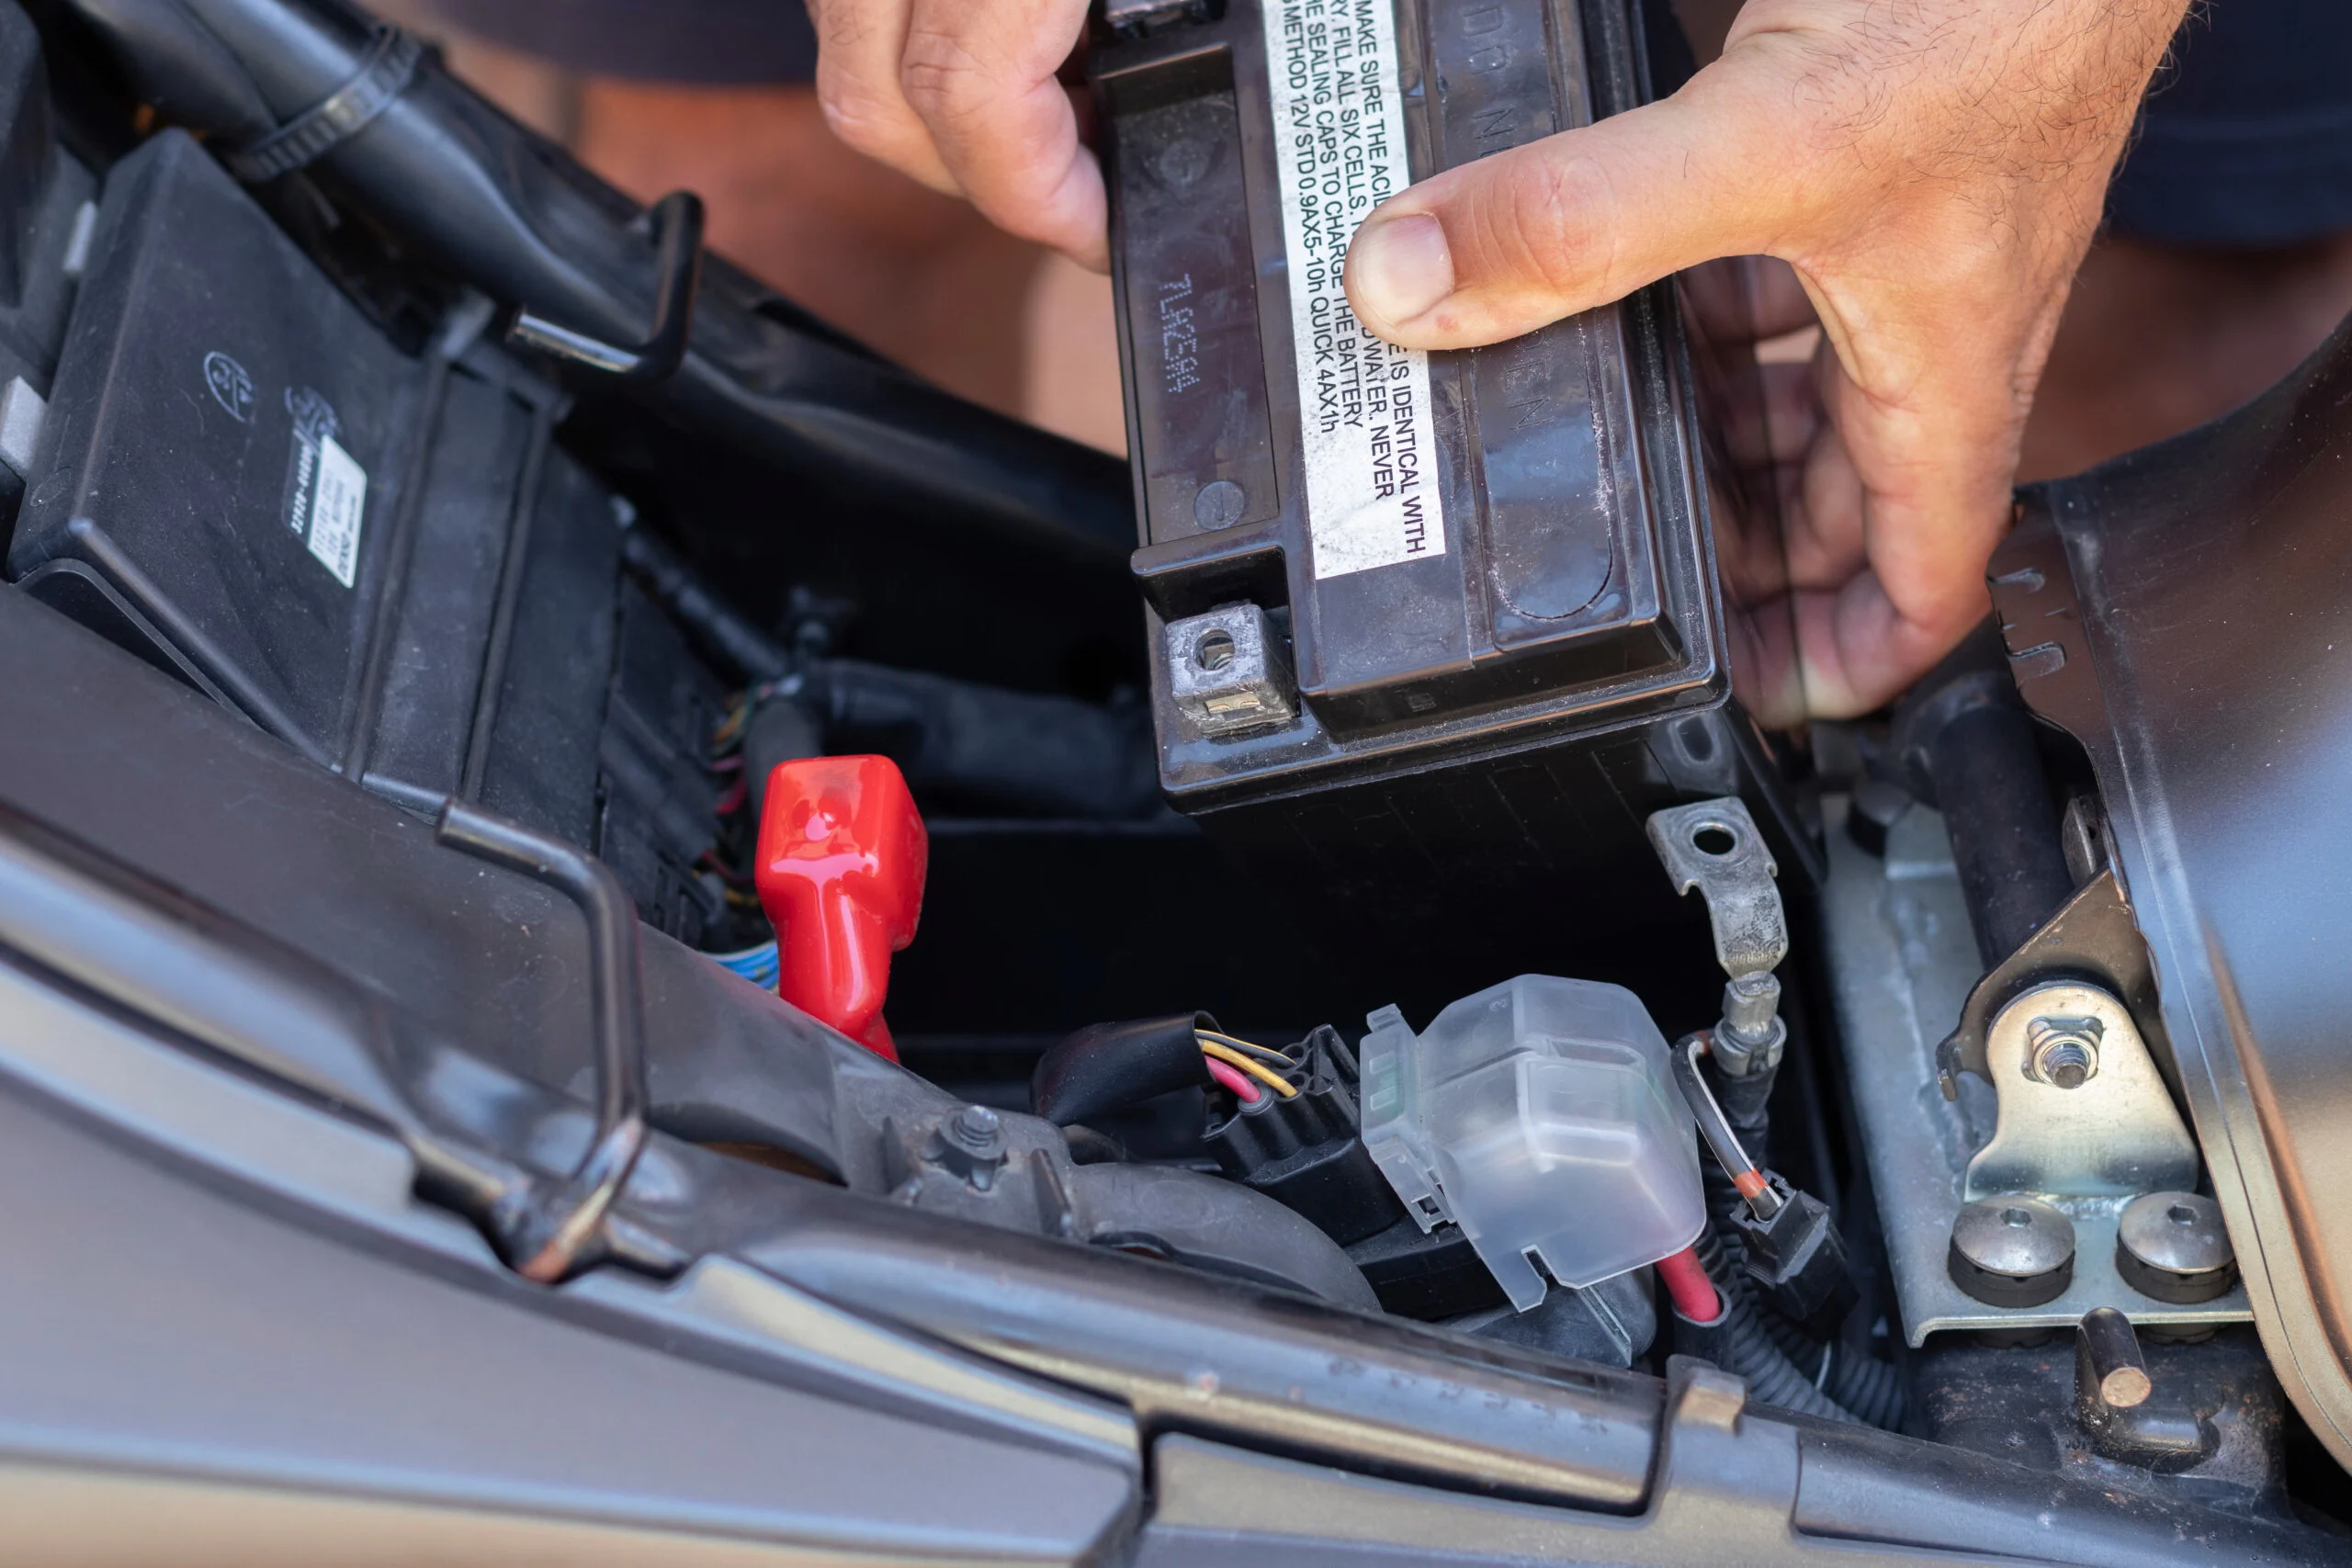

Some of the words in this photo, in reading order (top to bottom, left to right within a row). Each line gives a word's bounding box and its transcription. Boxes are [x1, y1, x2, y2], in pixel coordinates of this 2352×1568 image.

[1283, 6, 1307, 90] METHOD
[1332, 26, 1353, 68] FILL
[1355, 0, 1377, 56] MAKE
[1306, 22, 1332, 106] SEALING
[1336, 70, 1356, 106] ALL
[1360, 60, 1383, 116] SURE
[1290, 95, 1312, 129] 12V
[1316, 110, 1338, 164] CAPS
[1340, 108, 1362, 143] SIX
[1366, 118, 1388, 161] THE
[1295, 134, 1317, 175] STD
[1321, 166, 1341, 196] TO
[1344, 145, 1368, 217] CELLS.
[1324, 200, 1347, 289] CHARGE
[1310, 296, 1335, 366] QUICK
[1337, 337, 1363, 428] BATTERY
[1389, 359, 1410, 381] IS
[1317, 368, 1340, 434] 4AX1h
[1370, 424, 1395, 501] NEVER
[1392, 385, 1419, 494] IDENTICAL
[1402, 495, 1426, 554] WITH
